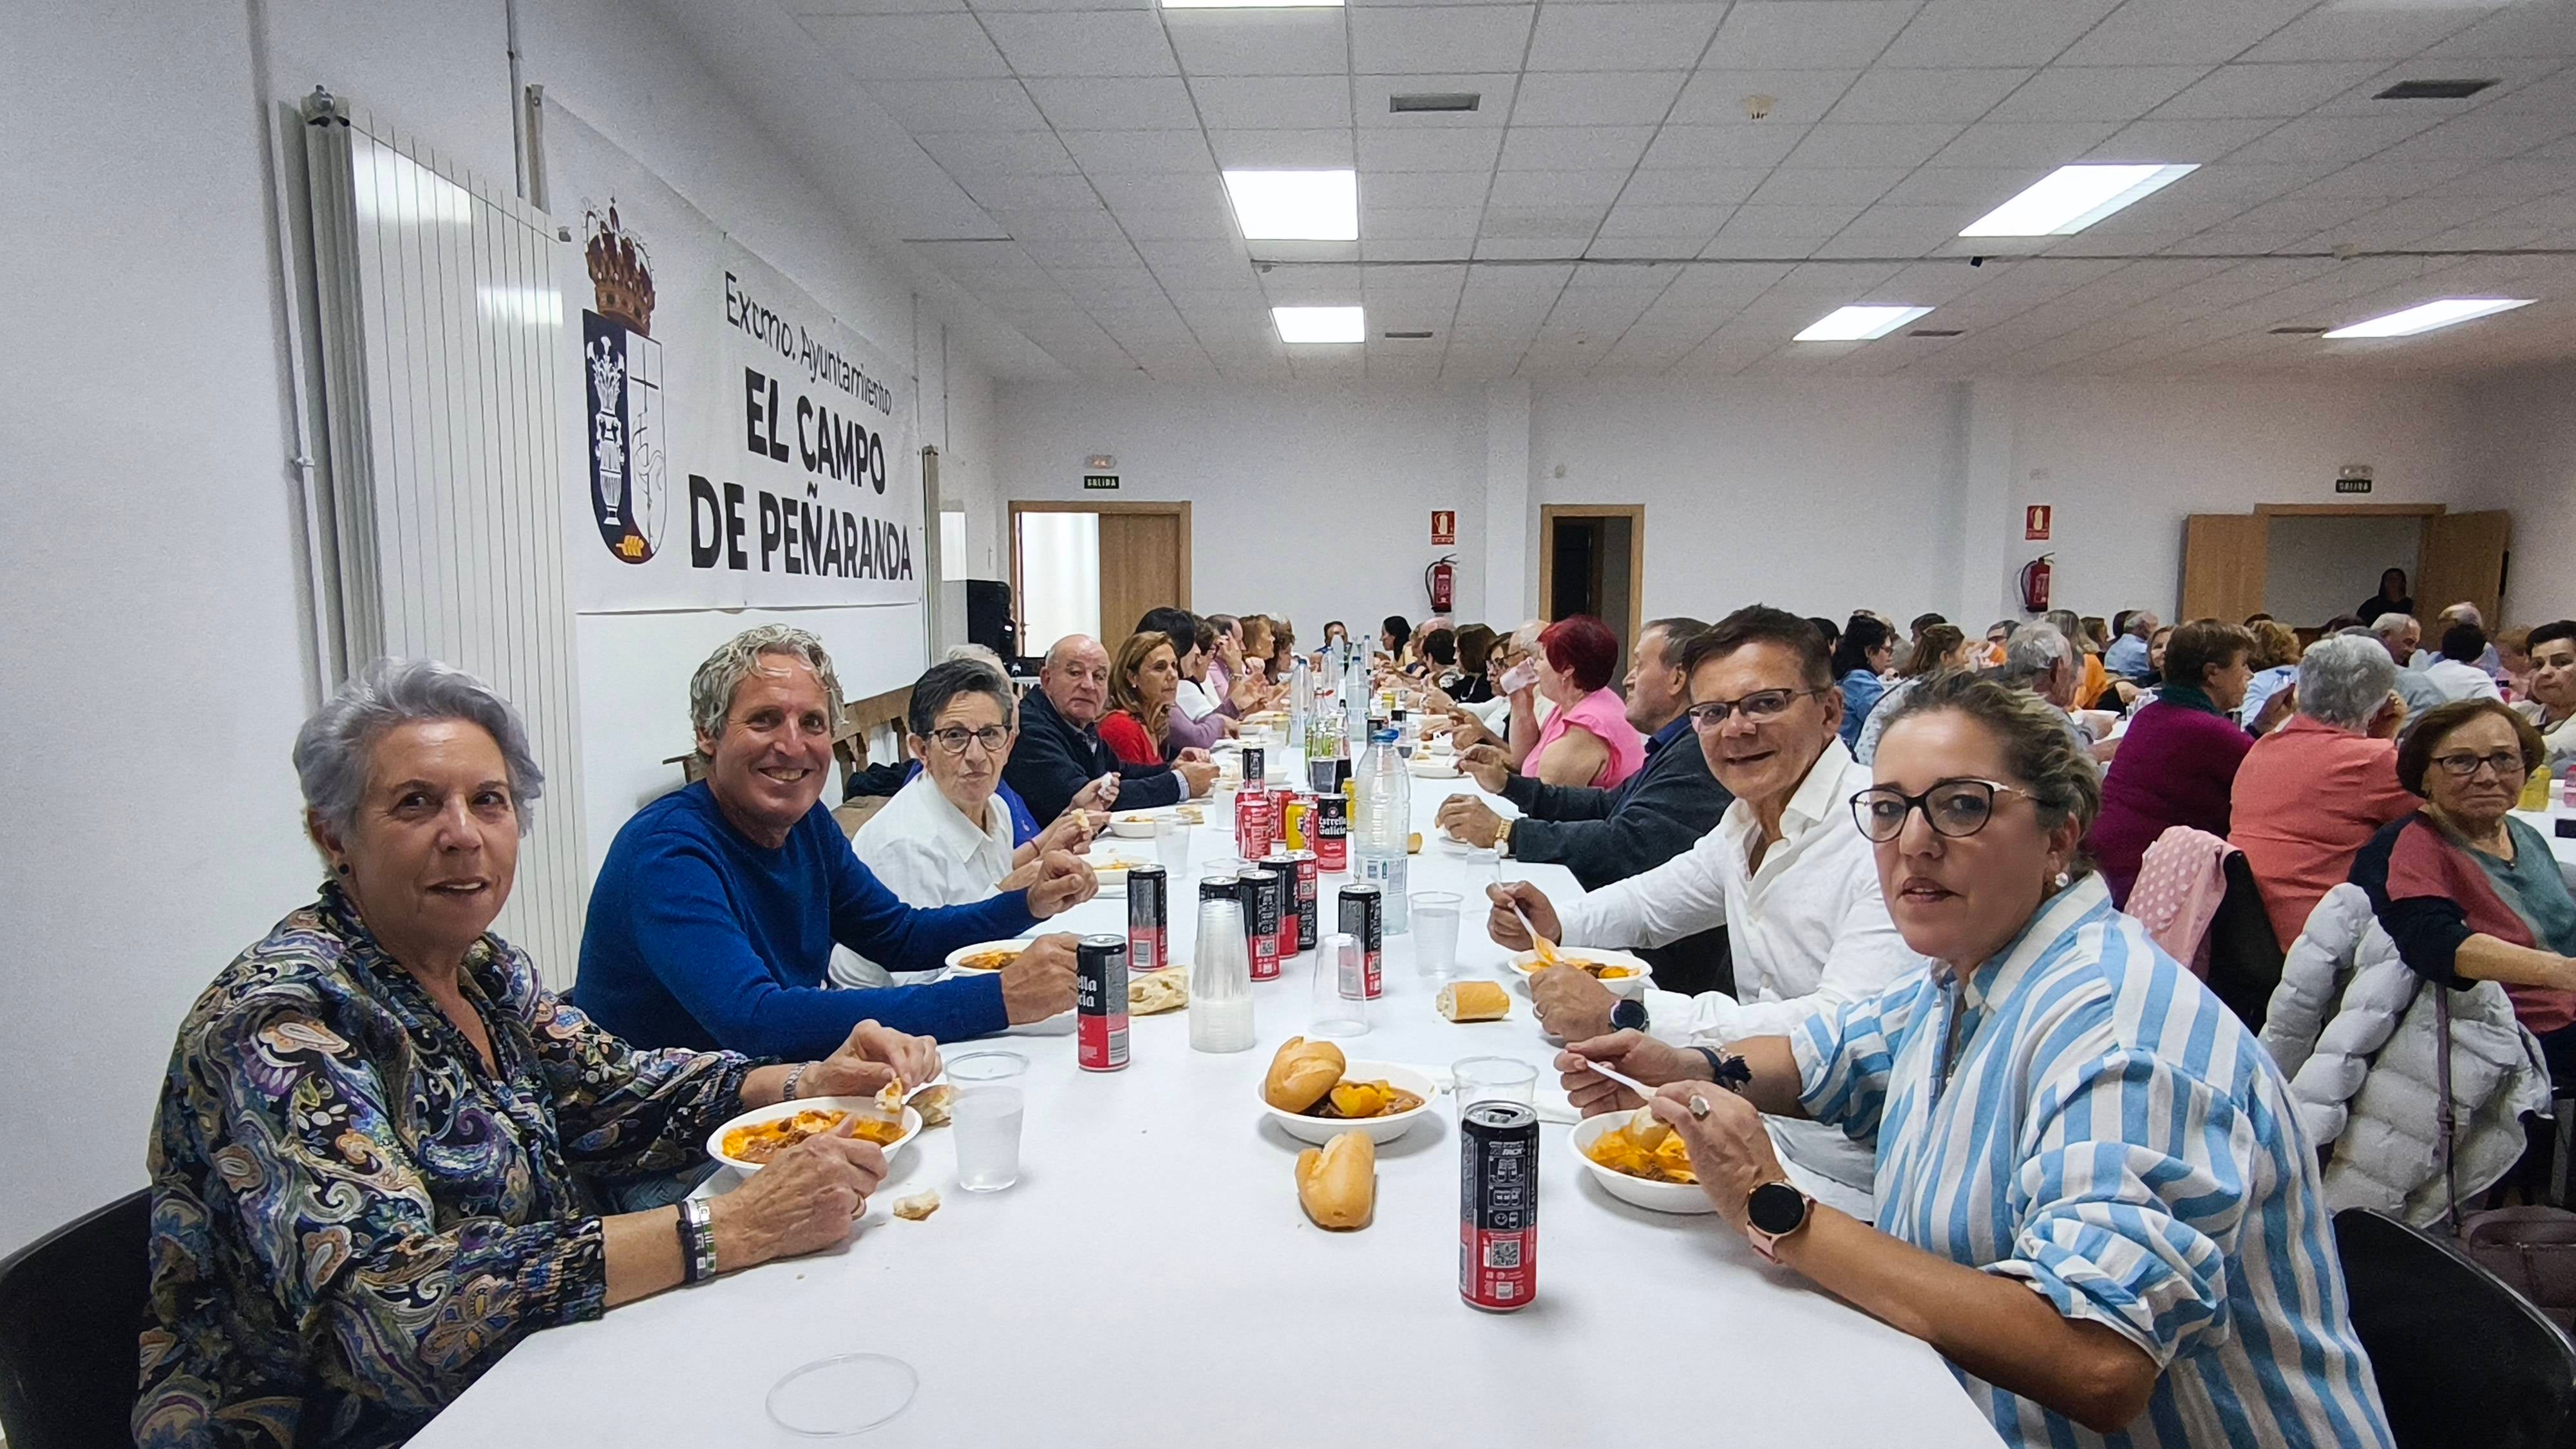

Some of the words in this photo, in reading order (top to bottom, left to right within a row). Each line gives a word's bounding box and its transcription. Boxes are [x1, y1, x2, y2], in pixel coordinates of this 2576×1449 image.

[724, 270, 796, 361] Excmo.
[800, 326, 893, 416] Ayuntamiento
[745, 366, 790, 464] EL
[797, 395, 886, 495] CAMPO
[1087, 478, 1116, 487] SALIDA
[688, 474, 749, 571] DE
[759, 482, 914, 581] PEÑARANDA
[1319, 825, 1346, 835] Galicia
